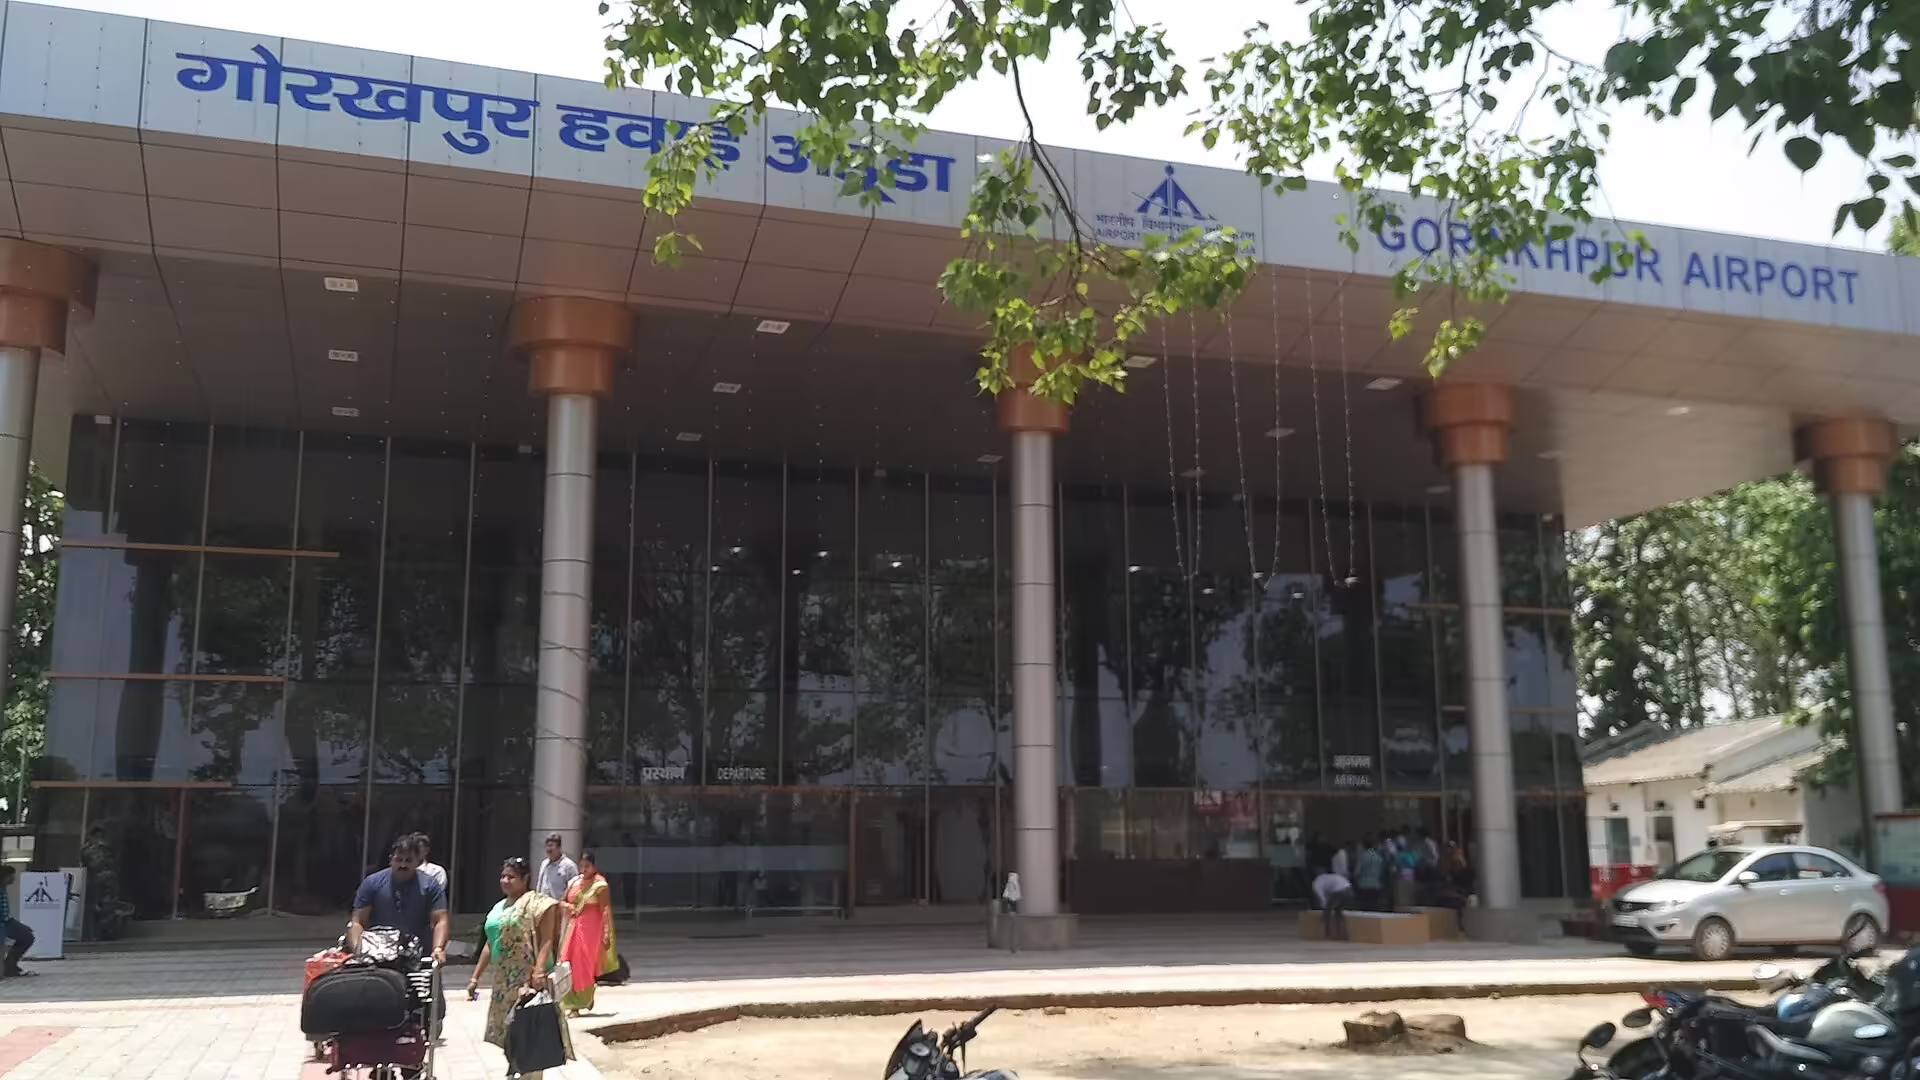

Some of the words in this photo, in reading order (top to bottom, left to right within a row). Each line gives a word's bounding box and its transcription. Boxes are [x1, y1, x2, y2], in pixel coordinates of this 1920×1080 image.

[176, 44, 540, 155] गोरखपुर
[1378, 214, 1663, 285] GORKHPUR
[1683, 251, 1859, 305] AIRPORT
[717, 767, 767, 780] DEPARTURE
